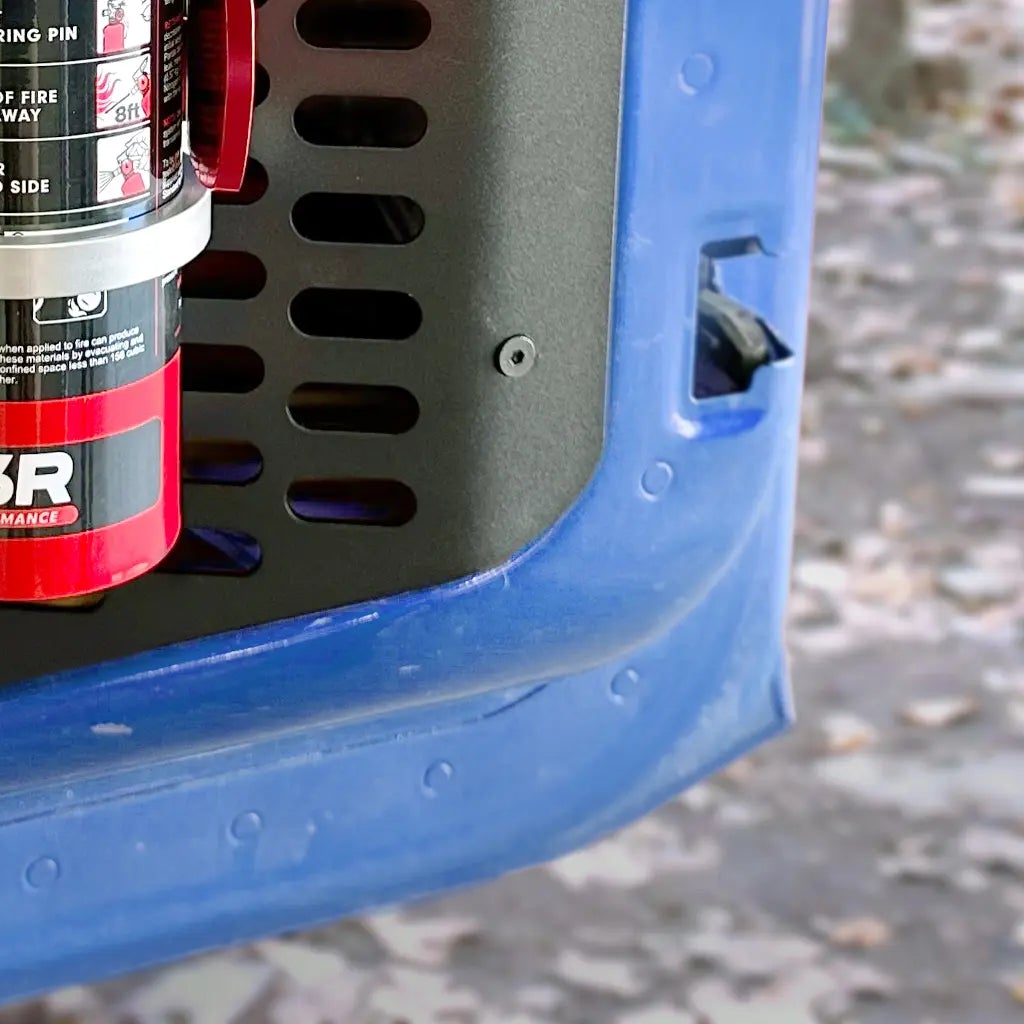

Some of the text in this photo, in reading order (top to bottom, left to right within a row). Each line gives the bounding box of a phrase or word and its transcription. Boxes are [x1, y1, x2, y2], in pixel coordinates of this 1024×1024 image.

[47, 25, 78, 42] PIN
[21, 89, 58, 104] FIRE
[115, 102, 140, 123] 8ft
[10, 179, 50, 194] SIDE
[26, 341, 61, 354] applied
[63, 341, 73, 351] to
[74, 338, 89, 349] fire
[91, 335, 107, 347] can
[109, 326, 139, 345] produce
[26, 351, 70, 364] materials
[71, 350, 83, 361] by
[84, 340, 129, 358] evacuating
[38, 363, 66, 375] space
[69, 361, 87, 371] less
[89, 356, 108, 368] than
